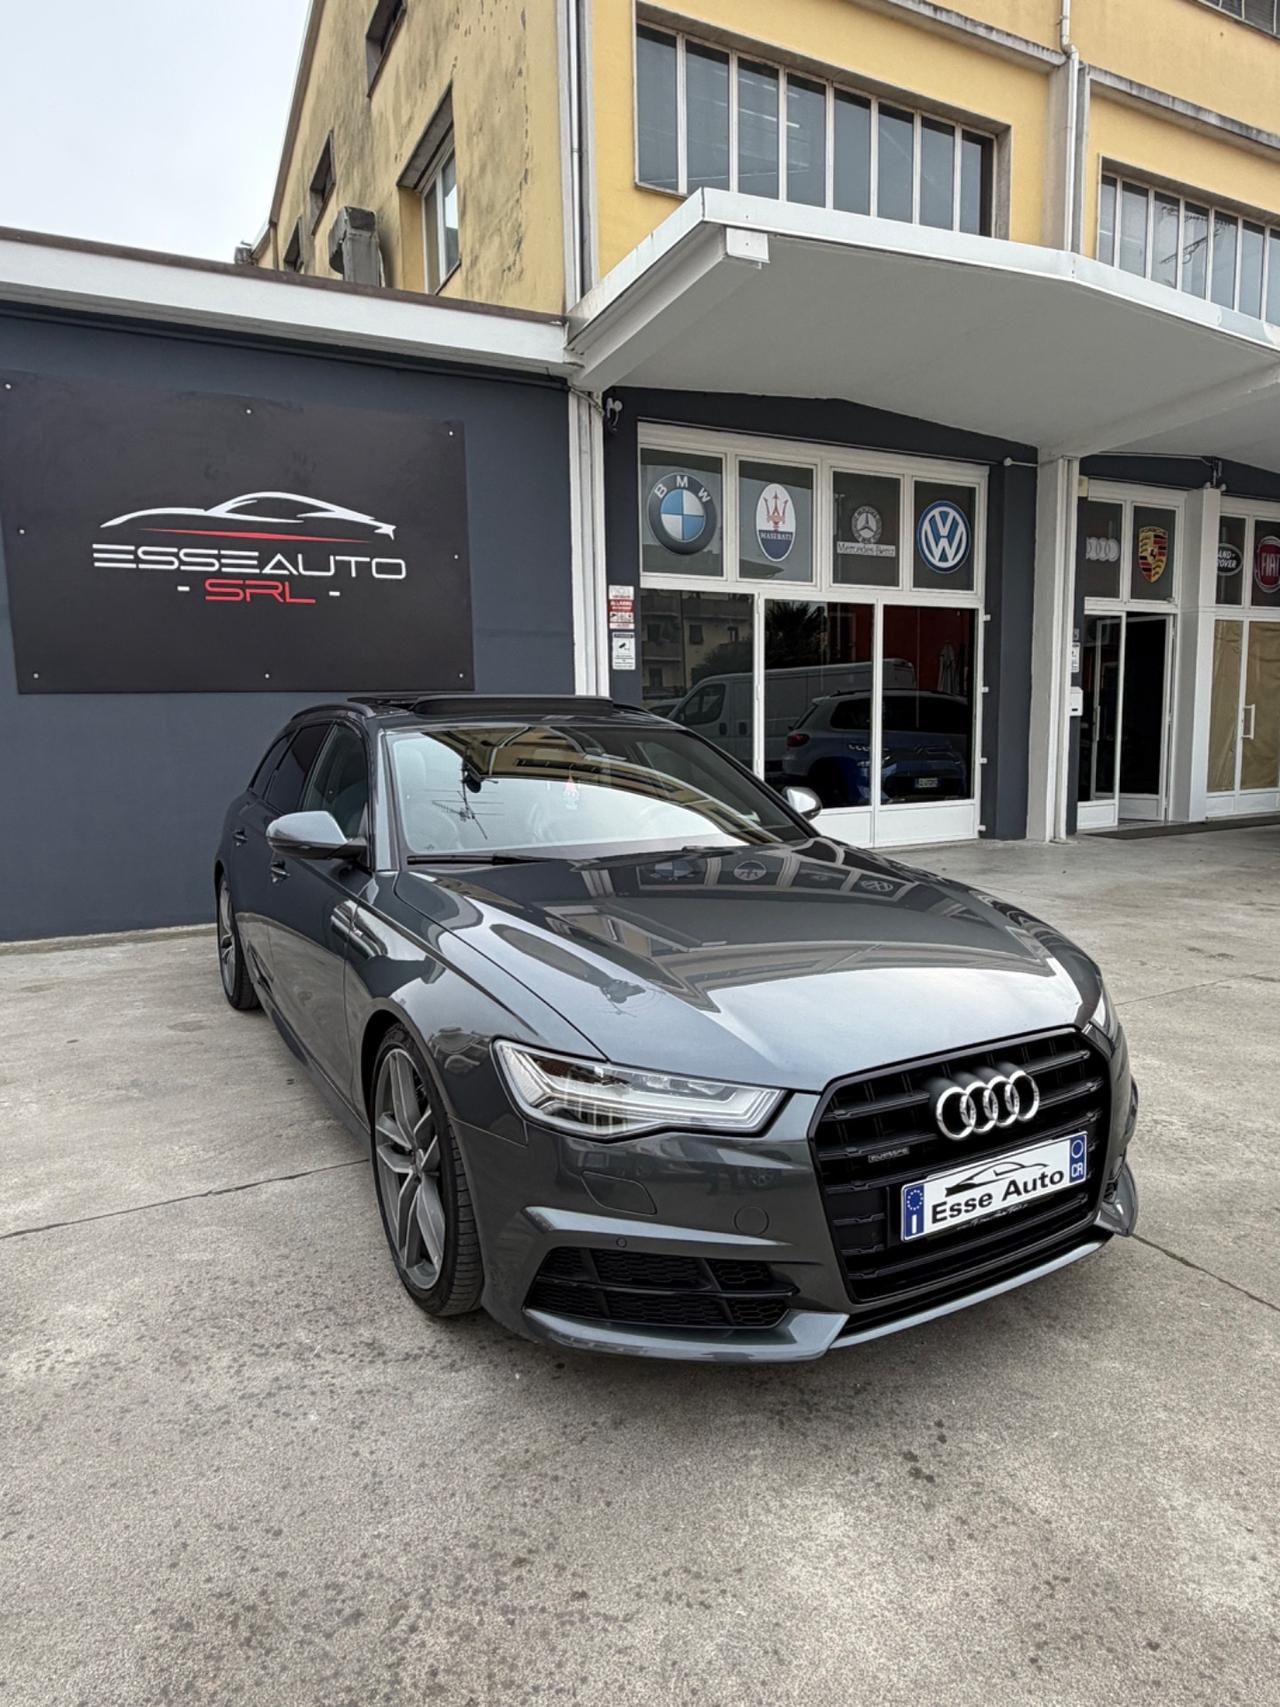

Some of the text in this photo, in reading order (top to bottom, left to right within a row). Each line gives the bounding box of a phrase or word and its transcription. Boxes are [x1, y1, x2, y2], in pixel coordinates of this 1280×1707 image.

[654, 475, 711, 503] BMW
[760, 532, 792, 541] MASERATI
[92, 543, 406, 580] ESSEAUTO
[204, 578, 317, 604] SRL
[1071, 1161, 1084, 1178] CR
[931, 1193, 993, 1225] Esse
[1001, 1169, 1065, 1202] Auto
[911, 1214, 917, 1234] I
